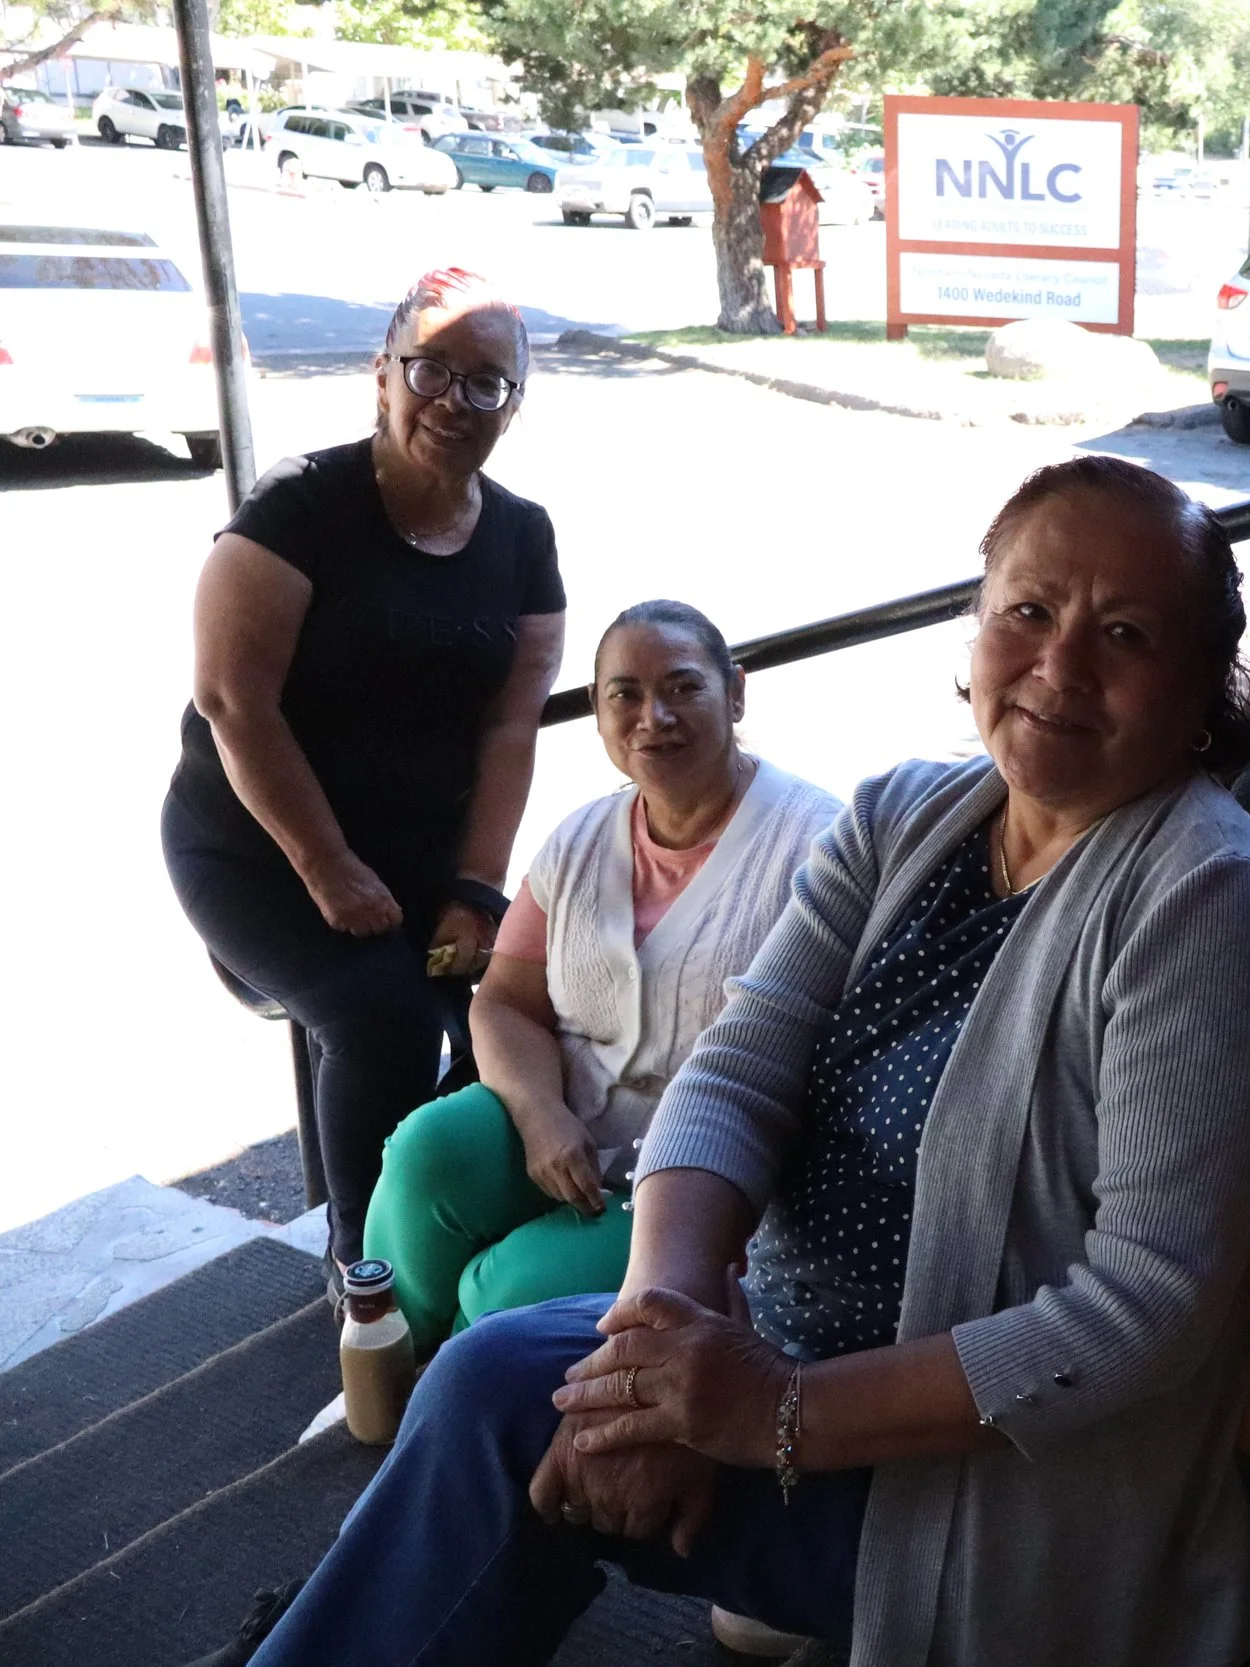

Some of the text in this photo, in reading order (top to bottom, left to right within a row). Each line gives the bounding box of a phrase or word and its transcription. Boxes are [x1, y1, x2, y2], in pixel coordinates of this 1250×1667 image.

[935, 158, 1083, 204] NNLC
[933, 218, 1088, 236] LEADING ADULTS TO SUCCESS
[937, 286, 1082, 307] 1400 Wedekind Road
